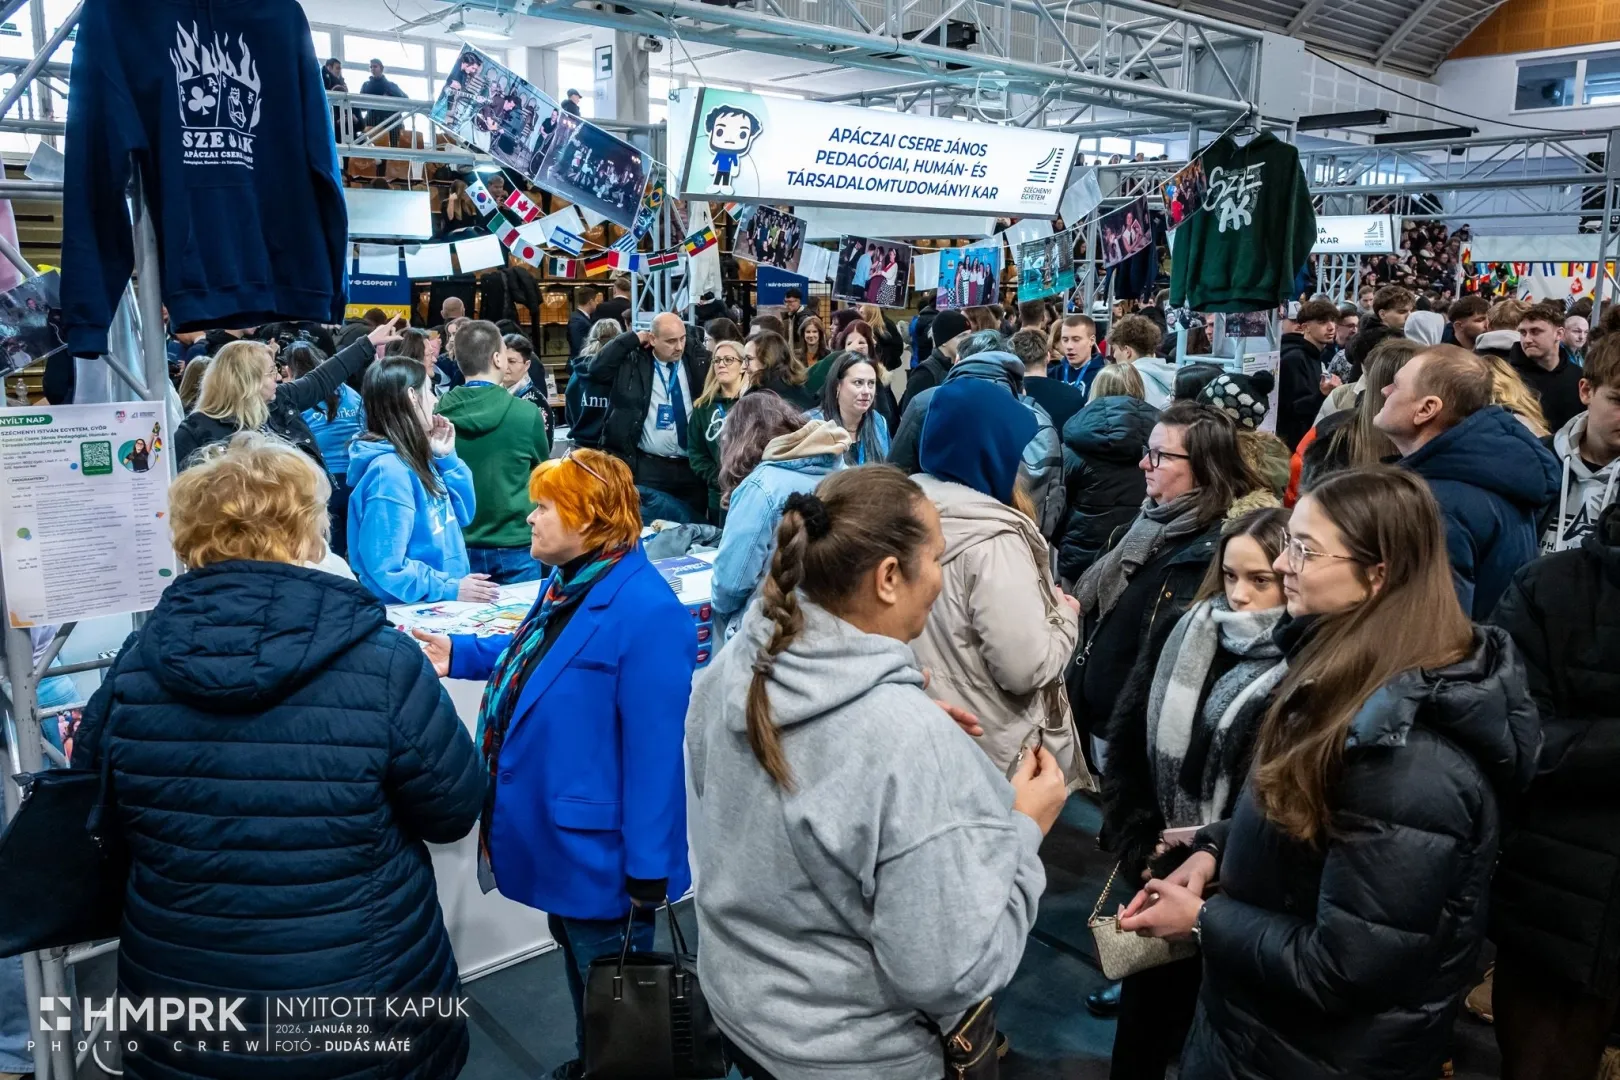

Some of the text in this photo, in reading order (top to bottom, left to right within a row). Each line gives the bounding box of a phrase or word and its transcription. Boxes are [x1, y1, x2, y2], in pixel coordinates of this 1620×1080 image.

[182, 131, 224, 148] SZE
[184, 149, 218, 158] APÁCZAI
[829, 126, 988, 156] APÁCZAI CSERE JÁNOS
[816, 150, 988, 178] PEDAGÓGIAI, HUMÁN- ÉS
[787, 168, 998, 200] TÁRSADALOMTUDOMÁNYI KAR
[1023, 186, 1052, 194] SZÉCHENYI
[1202, 162, 1266, 211] SZE
[1218, 195, 1252, 232] AK
